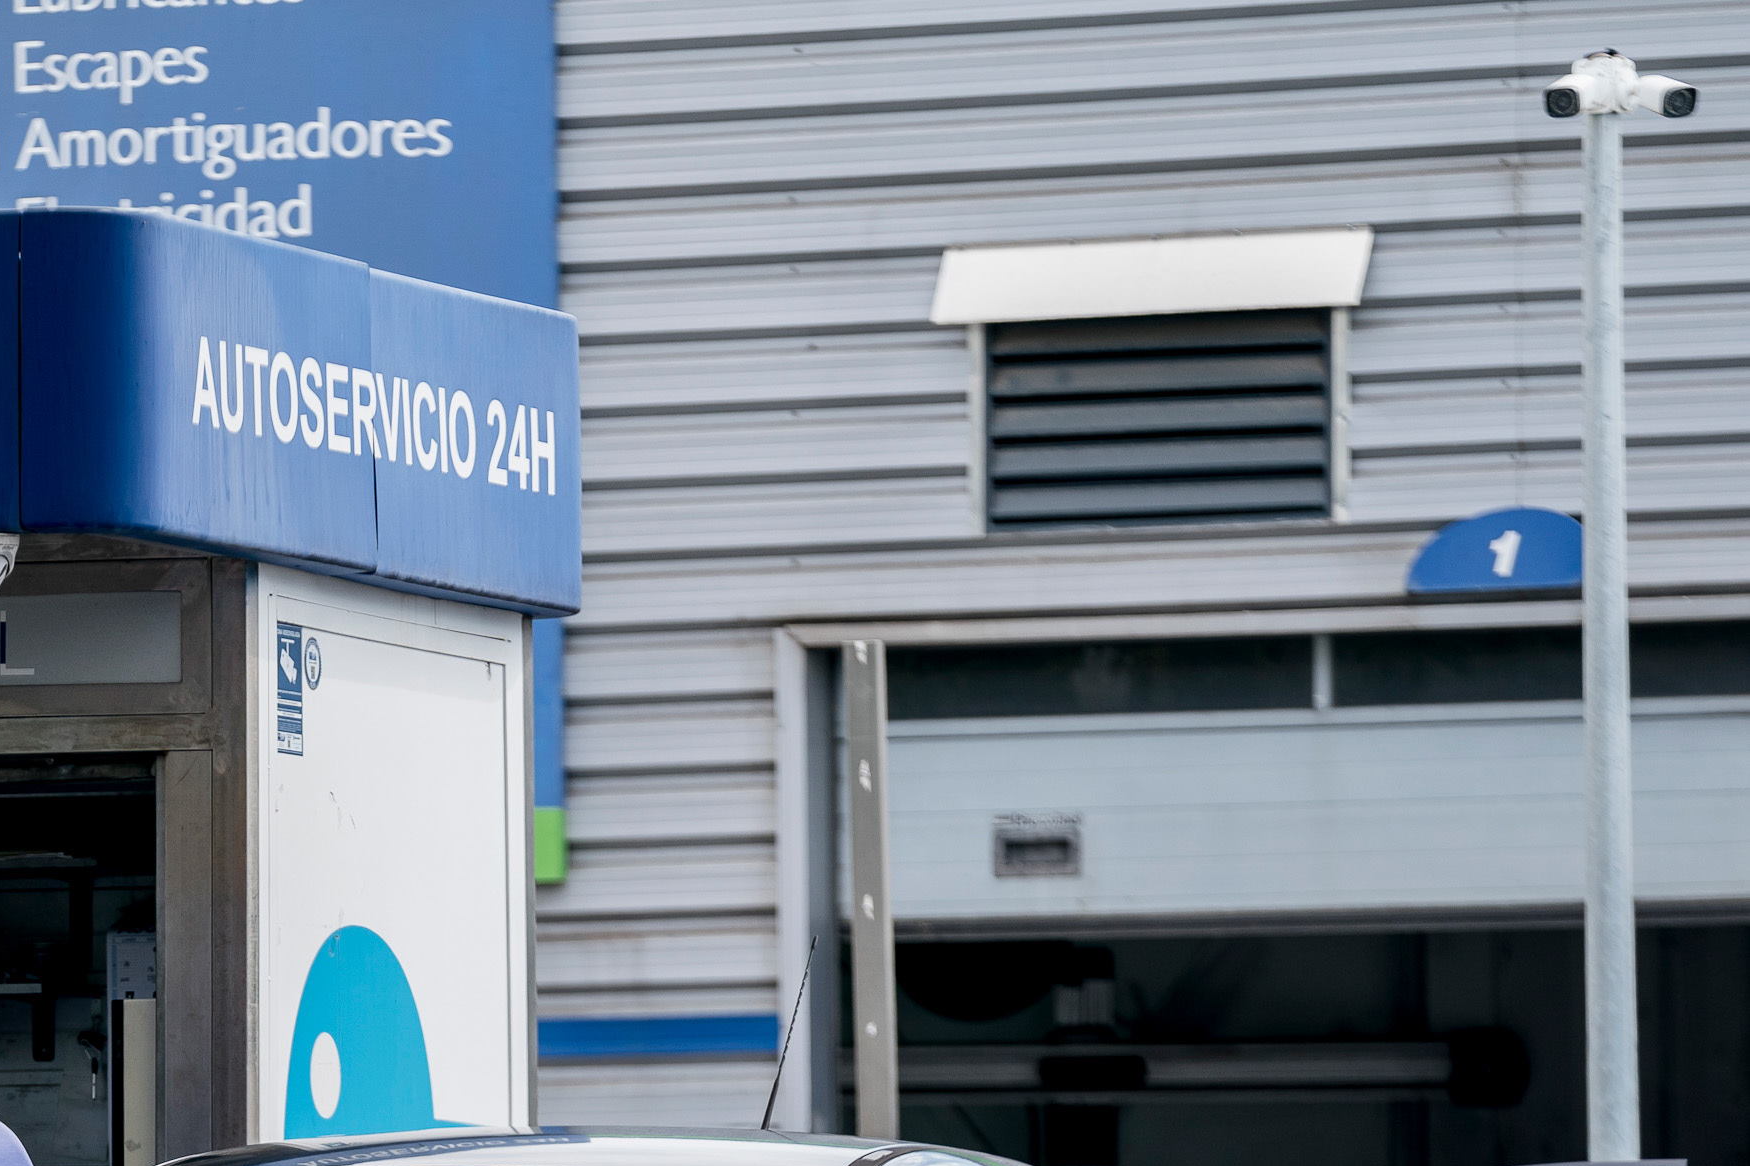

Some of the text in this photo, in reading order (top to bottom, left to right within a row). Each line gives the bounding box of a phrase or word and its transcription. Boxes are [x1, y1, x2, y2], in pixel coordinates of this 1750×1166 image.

[14, 41, 209, 105] Escapes
[15, 107, 453, 180] Amortiguadores
[192, 336, 556, 496] AUTOSERVICIO 24H
[1488, 530, 1522, 578] 1
